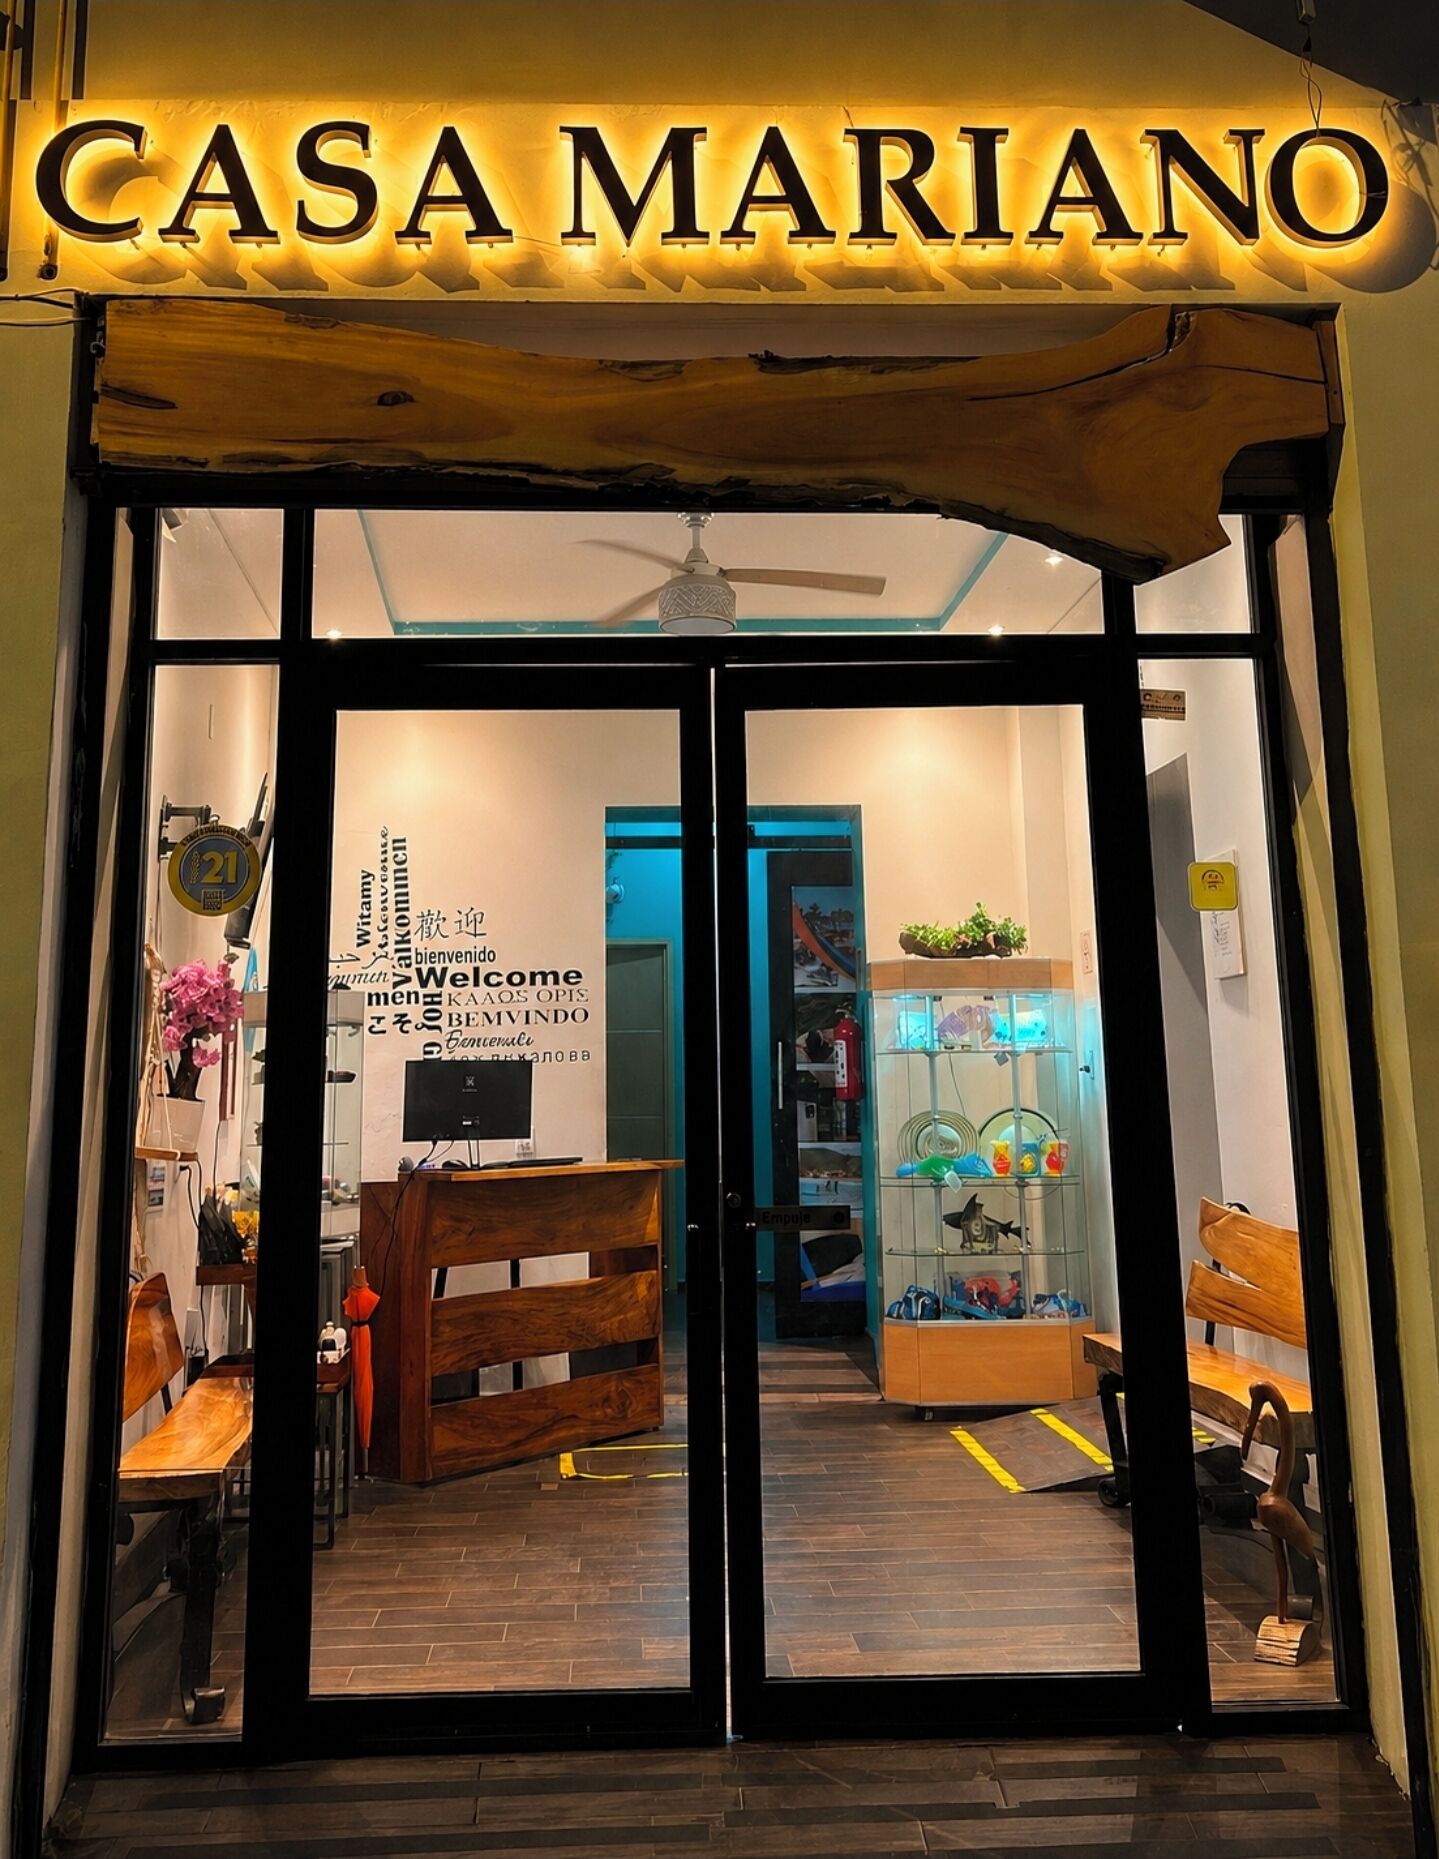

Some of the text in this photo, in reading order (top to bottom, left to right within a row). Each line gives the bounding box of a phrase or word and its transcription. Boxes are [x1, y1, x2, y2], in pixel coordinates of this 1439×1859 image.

[35, 120, 1390, 248] CASA MARIANO
[201, 849, 238, 885] 21
[356, 870, 375, 948] Witamy
[414, 906, 487, 942] 歡迎
[415, 946, 496, 965] bienvenido
[415, 966, 583, 989] Welcome
[367, 1012, 412, 1035] こそ
[448, 1007, 589, 1028] BEMVINDO
